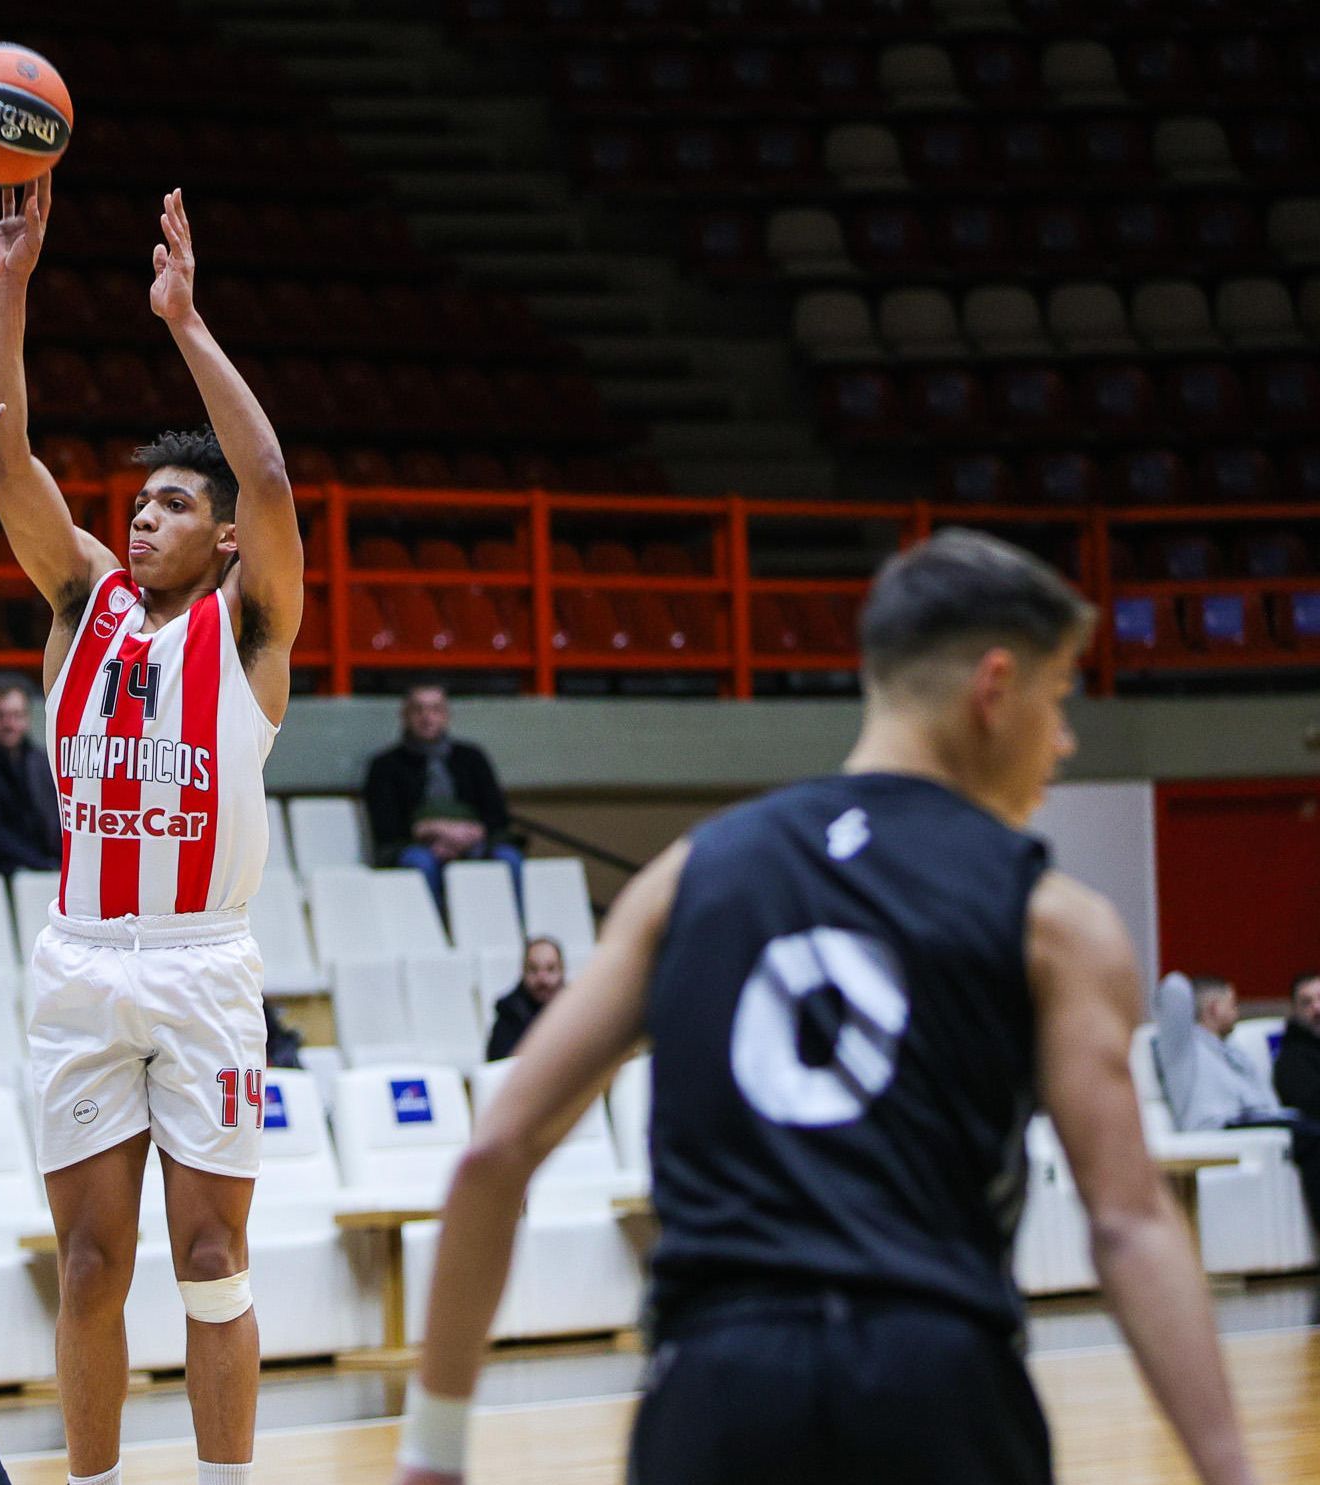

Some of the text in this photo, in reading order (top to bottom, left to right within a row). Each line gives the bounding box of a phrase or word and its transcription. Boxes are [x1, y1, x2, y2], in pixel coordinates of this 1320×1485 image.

[100, 659, 161, 721] 14
[60, 735, 210, 792] OLYMPIACOS
[76, 803, 205, 837] FlexCar
[730, 926, 909, 1127] 0
[216, 1067, 262, 1129] 14
